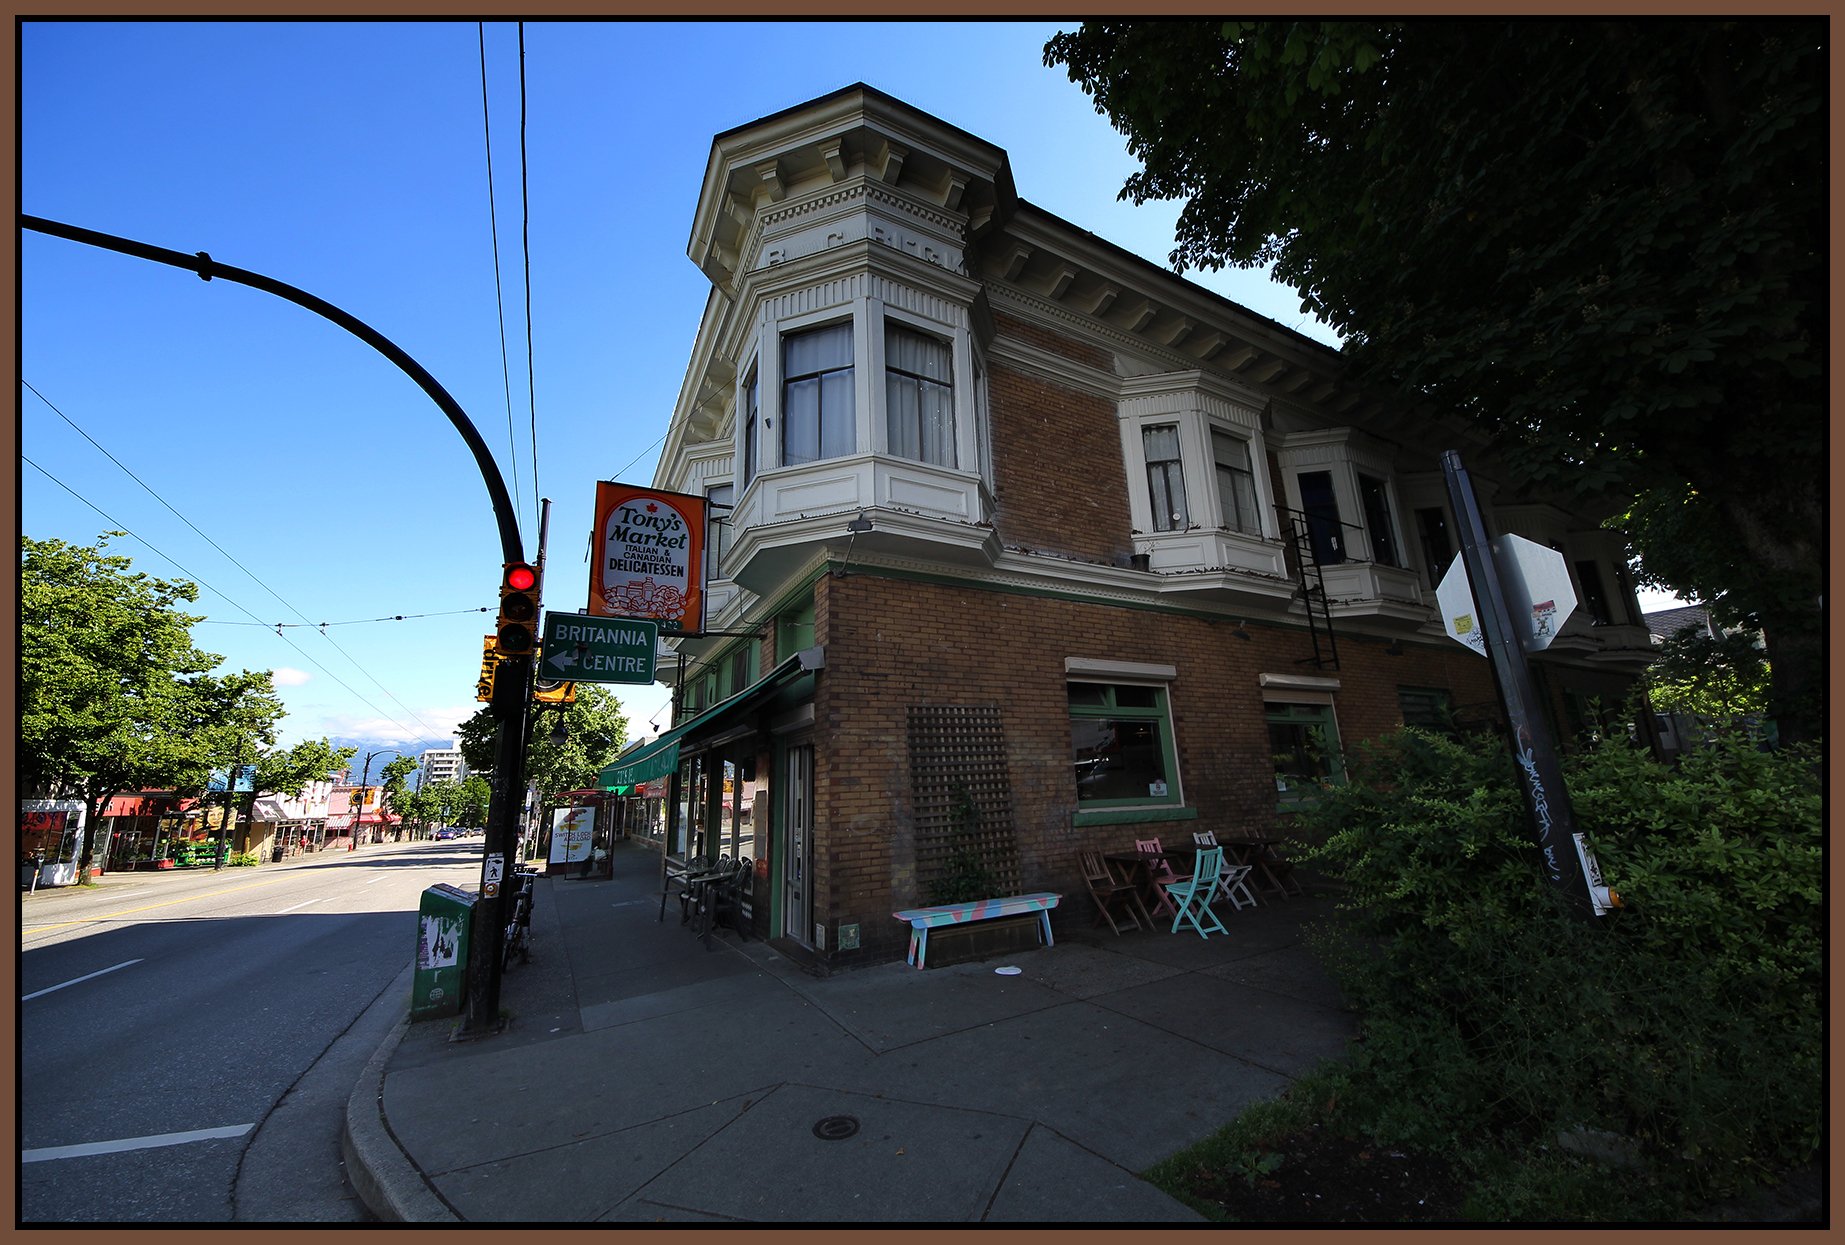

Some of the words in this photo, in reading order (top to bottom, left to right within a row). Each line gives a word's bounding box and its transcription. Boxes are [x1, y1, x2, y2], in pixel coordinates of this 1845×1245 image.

[619, 506, 683, 531] Tony's
[608, 525, 688, 550] Market
[623, 552, 672, 564] CANADIAN
[625, 544, 659, 555] ITALIAN
[664, 549, 671, 557] &
[609, 558, 684, 578] DELICATESSEN
[555, 624, 648, 647] BRITANNIA
[583, 655, 647, 673] CENTRE
